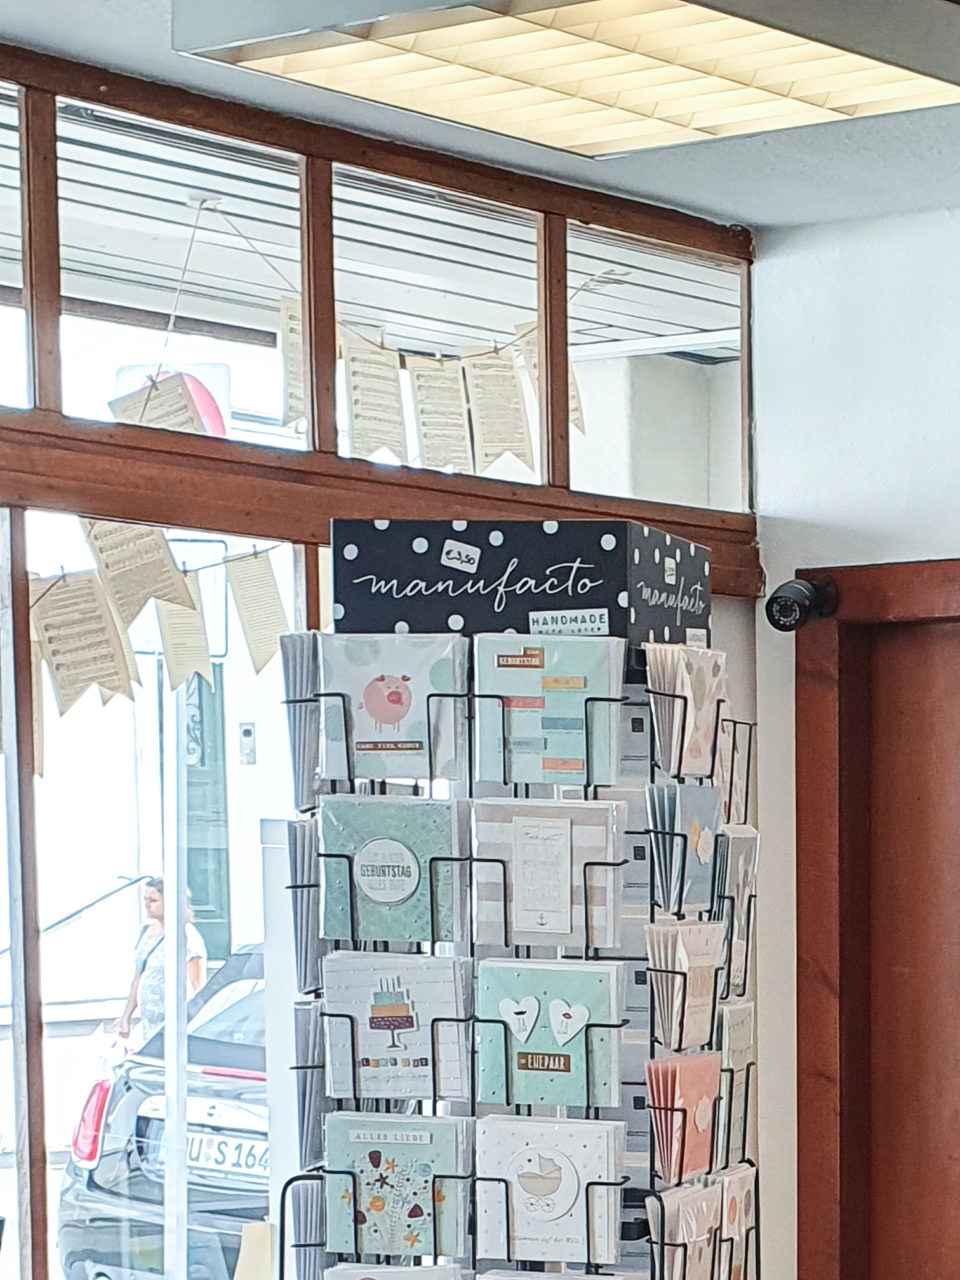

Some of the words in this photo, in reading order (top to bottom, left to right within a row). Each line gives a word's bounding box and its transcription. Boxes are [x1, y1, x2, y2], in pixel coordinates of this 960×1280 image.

[352, 557, 604, 612] manufacto
[636, 576, 706, 627] manufacto
[531, 613, 606, 626] HANDMADE
[360, 864, 412, 878] GEBURTSTAG
[527, 1054, 566, 1070] EHEPAAR
[354, 1132, 388, 1141] ALLES
[394, 1133, 425, 1142] LIEBE
[214, 1140, 228, 1165] S
